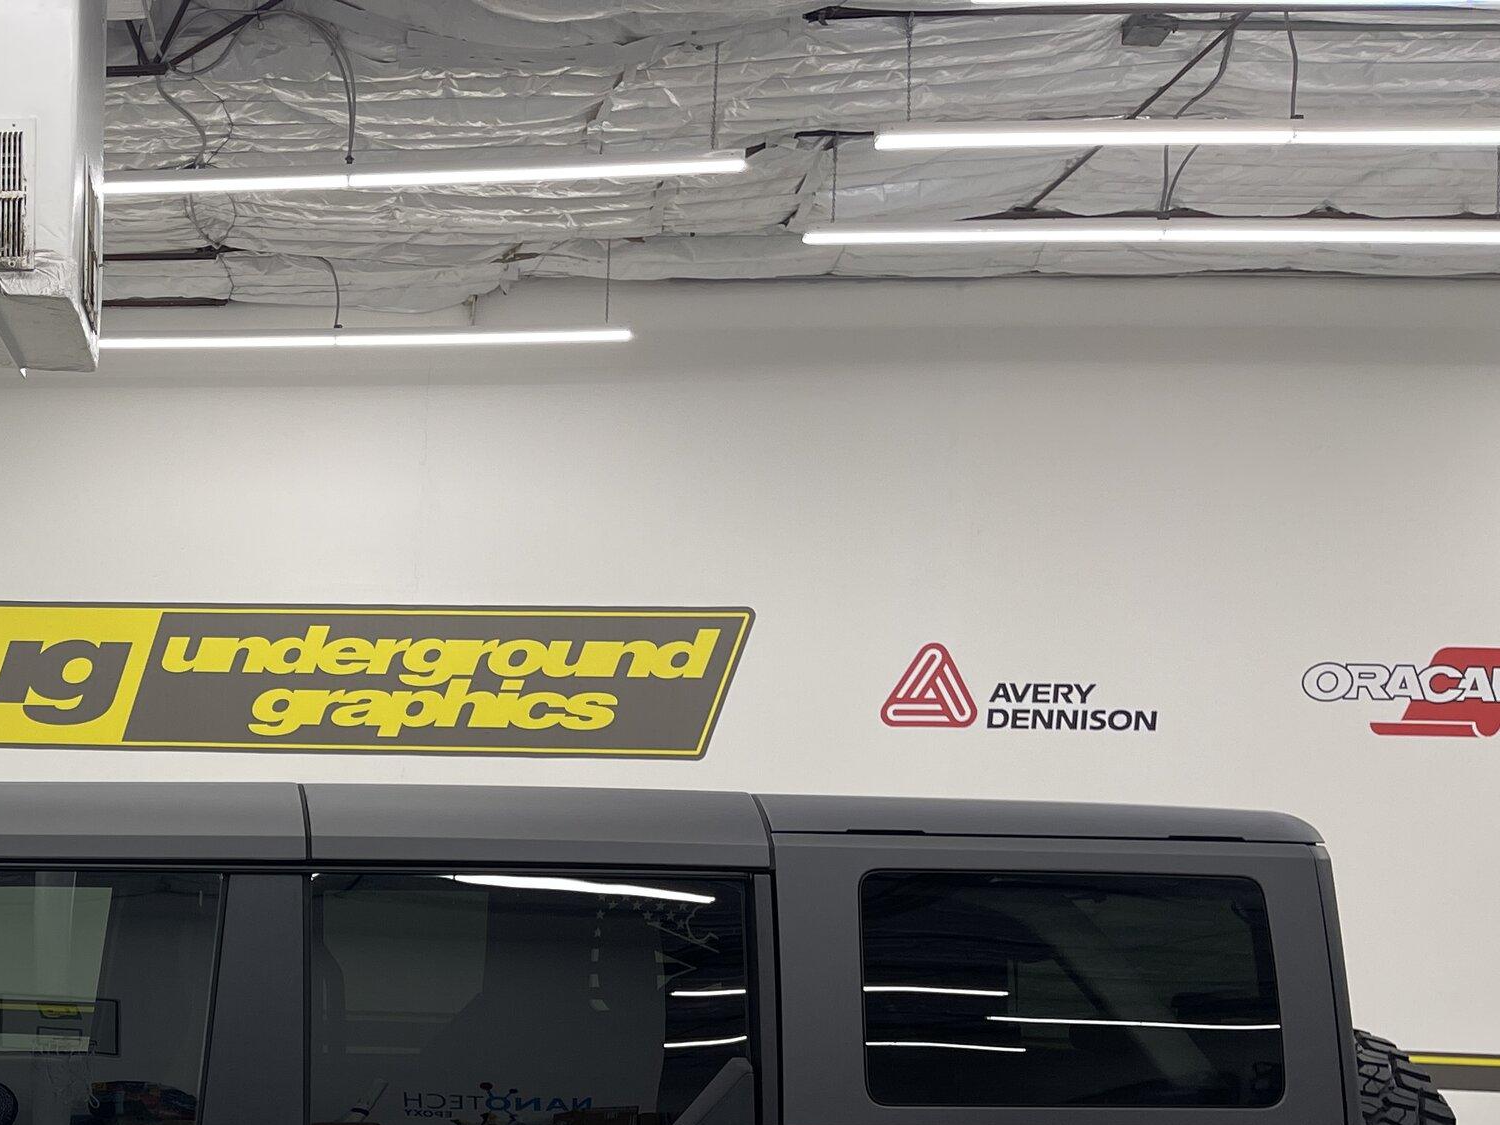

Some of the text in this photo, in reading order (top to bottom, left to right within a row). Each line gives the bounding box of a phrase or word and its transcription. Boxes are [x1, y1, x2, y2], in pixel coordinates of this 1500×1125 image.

[160, 625, 720, 687] underground
[248, 678, 617, 737] graphics
[989, 682, 1097, 704] AVERY
[986, 709, 1158, 732] DENNISON
